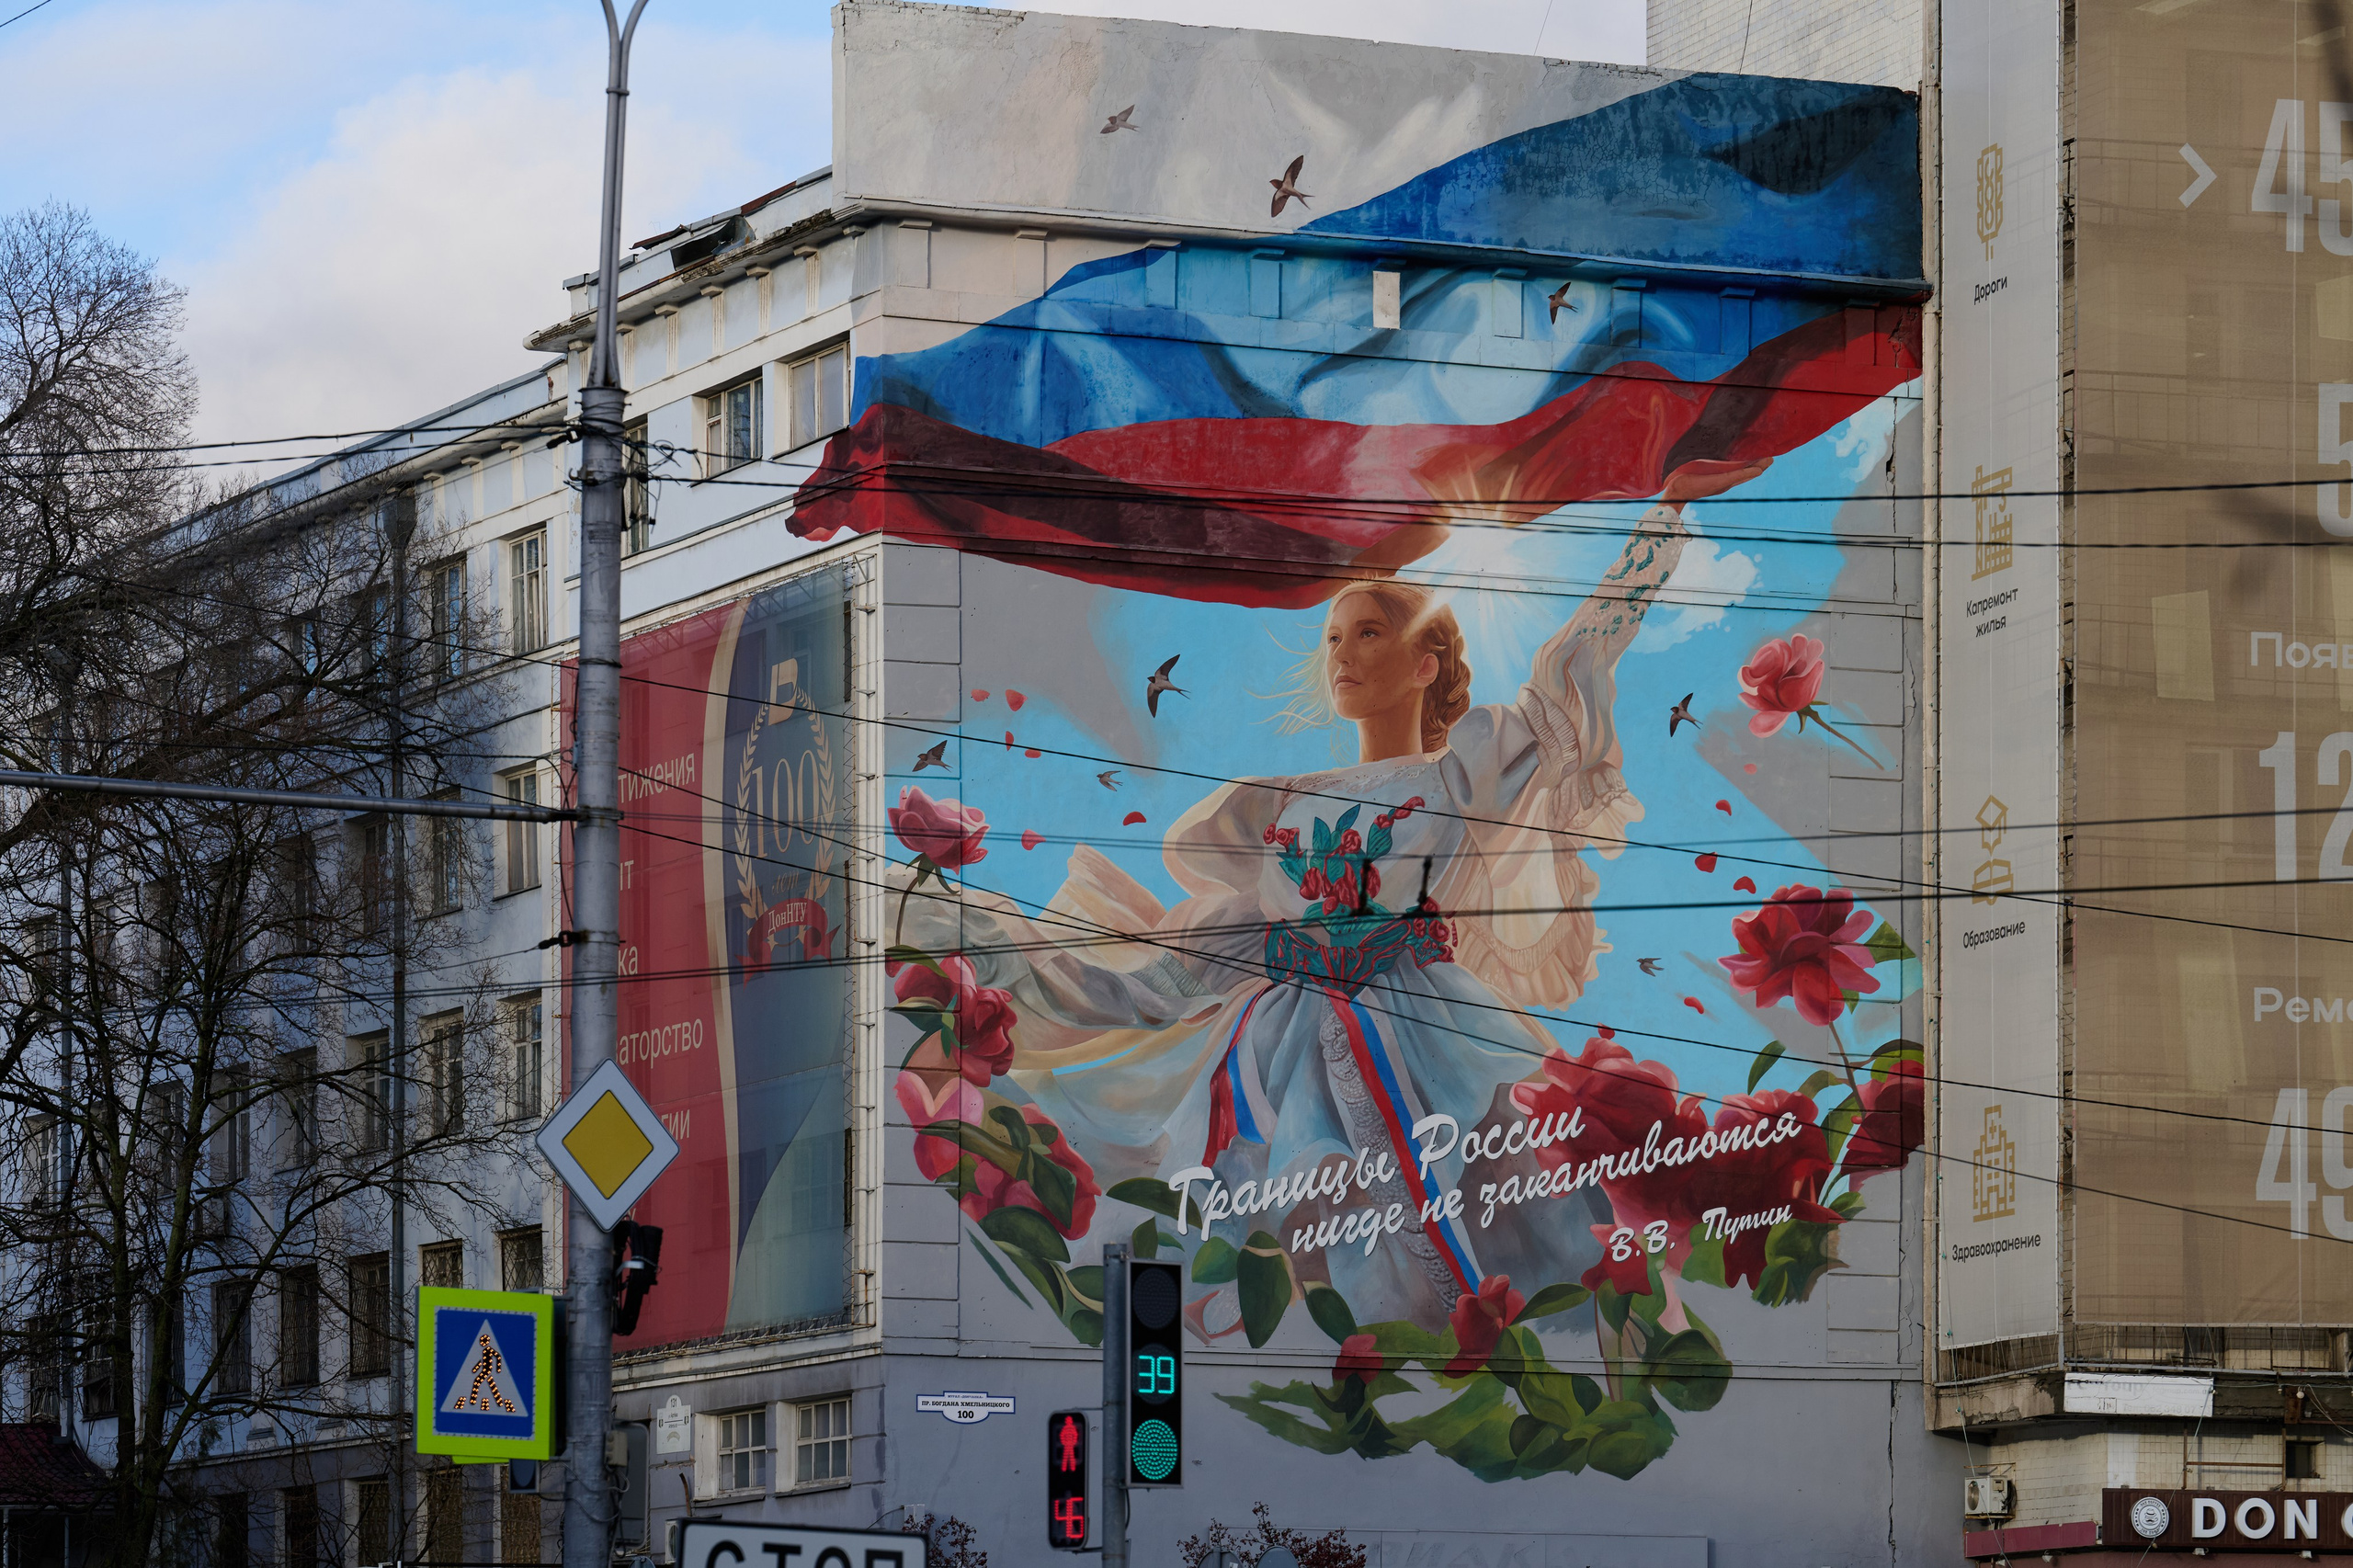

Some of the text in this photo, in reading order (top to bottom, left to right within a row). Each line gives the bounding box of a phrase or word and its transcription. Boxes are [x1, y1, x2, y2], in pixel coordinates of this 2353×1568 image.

[1974, 276, 2007, 306] Дороги
[1966, 588, 2018, 618] Капремонт
[1975, 615, 2006, 638] жилья
[618, 753, 695, 803] тижения
[751, 749, 820, 859] 100
[772, 872, 799, 895] лет
[768, 902, 807, 936] ДонНТУ
[1962, 921, 2026, 950] Образование
[2254, 986, 2353, 1023] Рем
[617, 1018, 703, 1069] аторство
[1168, 1106, 1586, 1241] Границы России
[1291, 1111, 1802, 1257] нигде не заканчиваются
[1701, 1204, 1793, 1244] Путин
[1952, 1233, 2041, 1264] Здравоохранение
[1138, 1355, 1175, 1394] 39
[957, 1410, 974, 1419] 100
[1053, 1497, 1085, 1540] 46
[2192, 1497, 2317, 1540] DON
